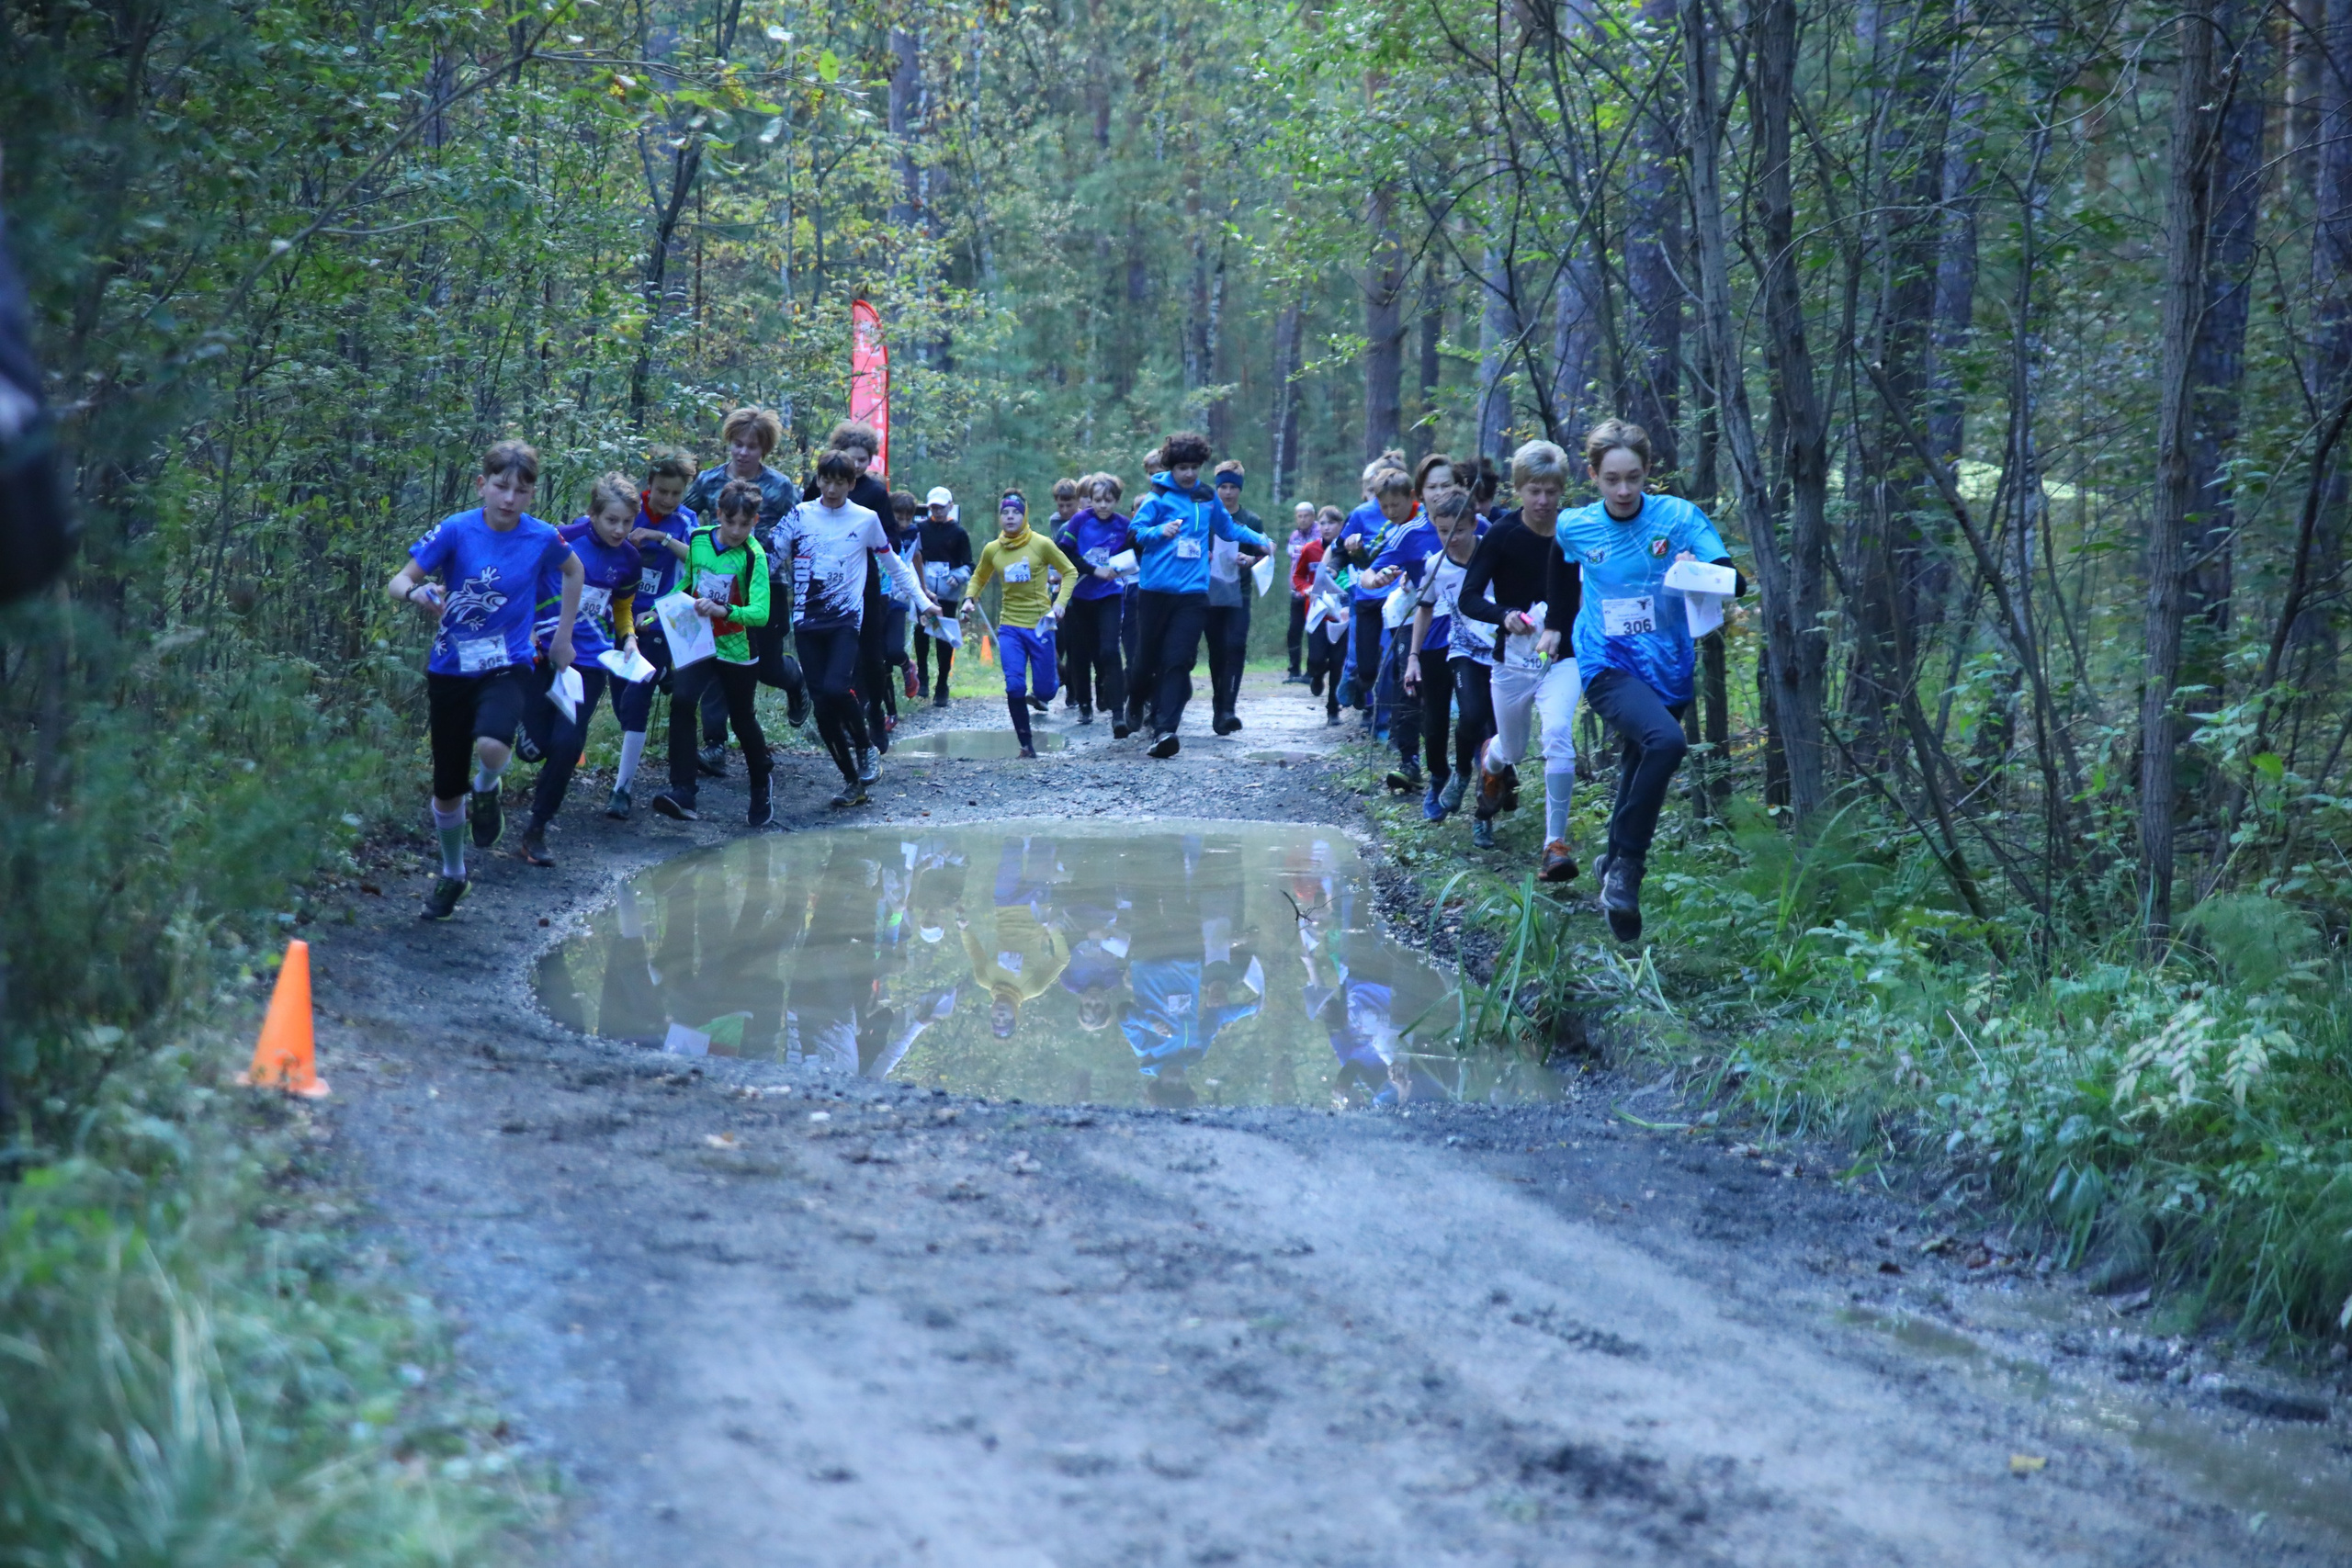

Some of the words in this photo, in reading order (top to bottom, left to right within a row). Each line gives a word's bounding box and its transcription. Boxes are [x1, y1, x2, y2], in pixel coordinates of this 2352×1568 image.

[827, 571, 844, 582] 325
[639, 581, 656, 593] 301
[707, 590, 728, 604] 304
[582, 603, 602, 615] 303
[1623, 618, 1653, 636] 306
[478, 654, 504, 671] 305
[1522, 657, 1543, 669] 310
